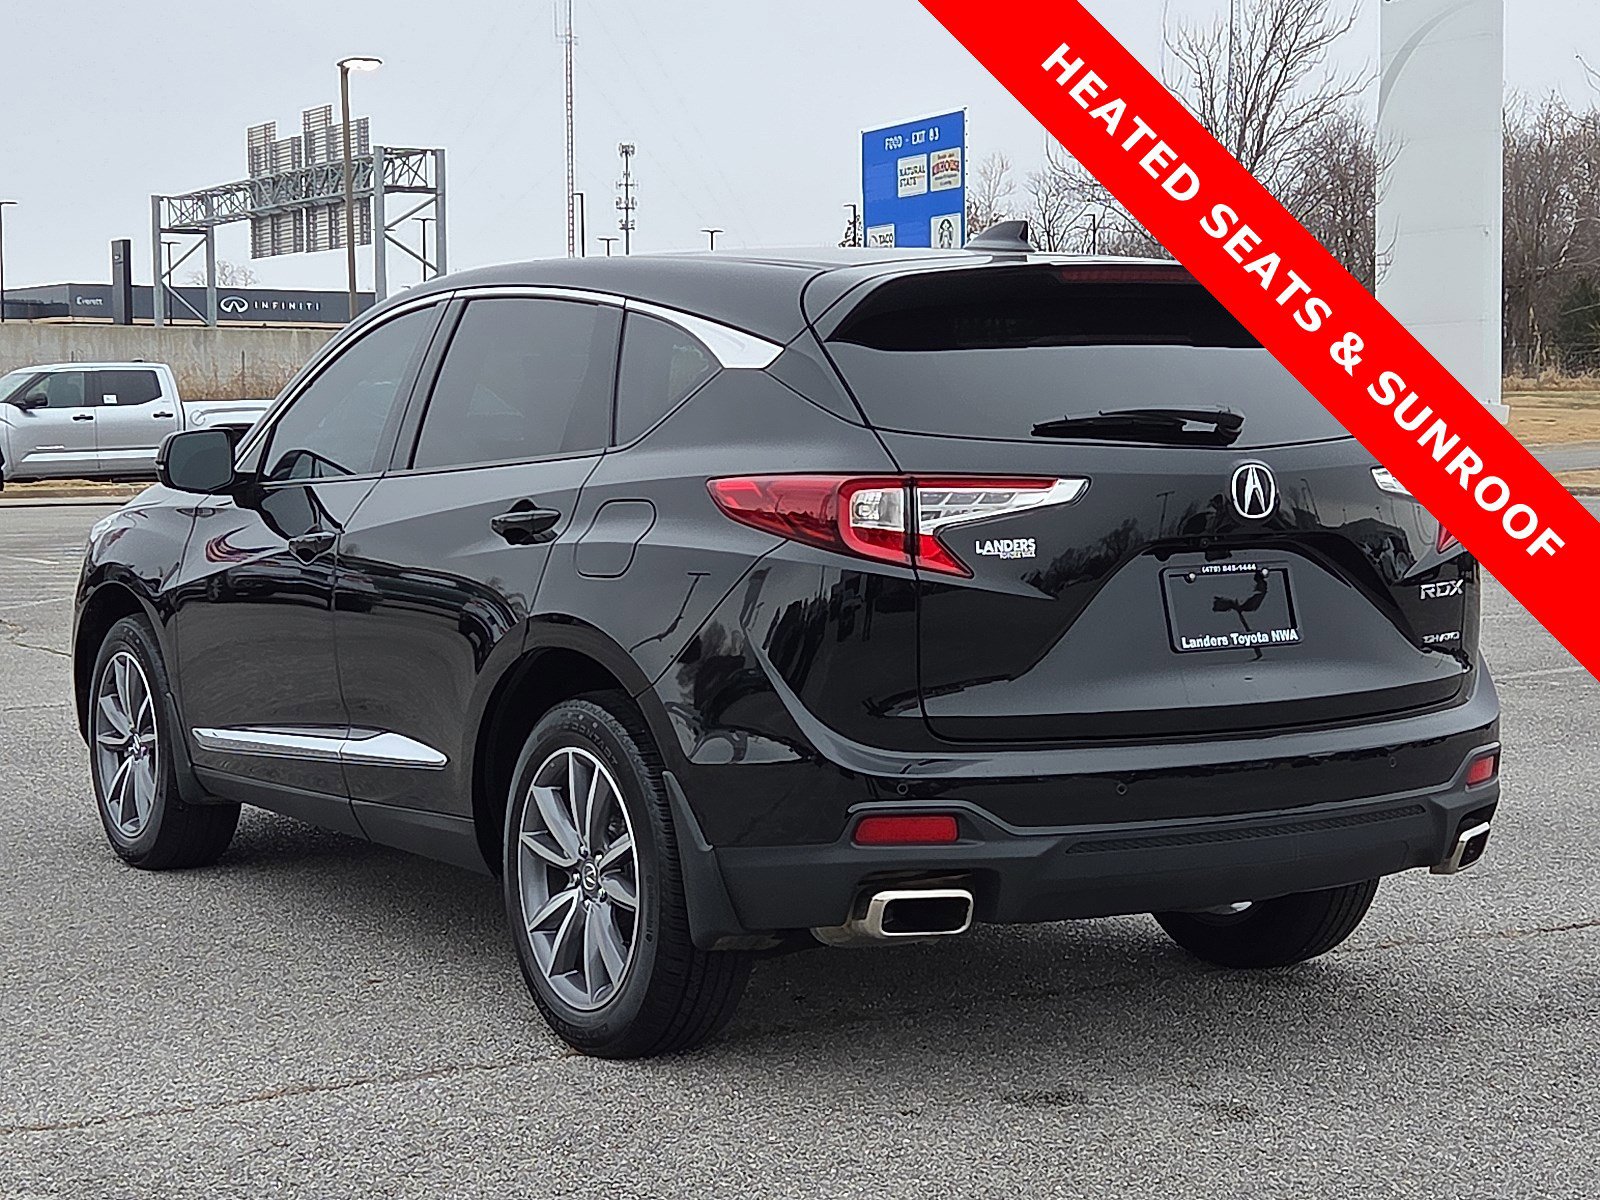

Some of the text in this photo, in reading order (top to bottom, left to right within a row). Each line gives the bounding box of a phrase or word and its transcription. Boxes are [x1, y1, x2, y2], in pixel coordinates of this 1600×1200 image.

[885, 135, 902, 150] FOOD
[912, 131, 926, 144] EXIT
[899, 165, 926, 176] NATURAL
[878, 233, 894, 245] TACO
[254, 301, 320, 311] INFINITI
[975, 538, 1036, 555] LANDERS
[1420, 579, 1464, 600] RDX
[1181, 628, 1299, 649] Landers Toyota NWA
